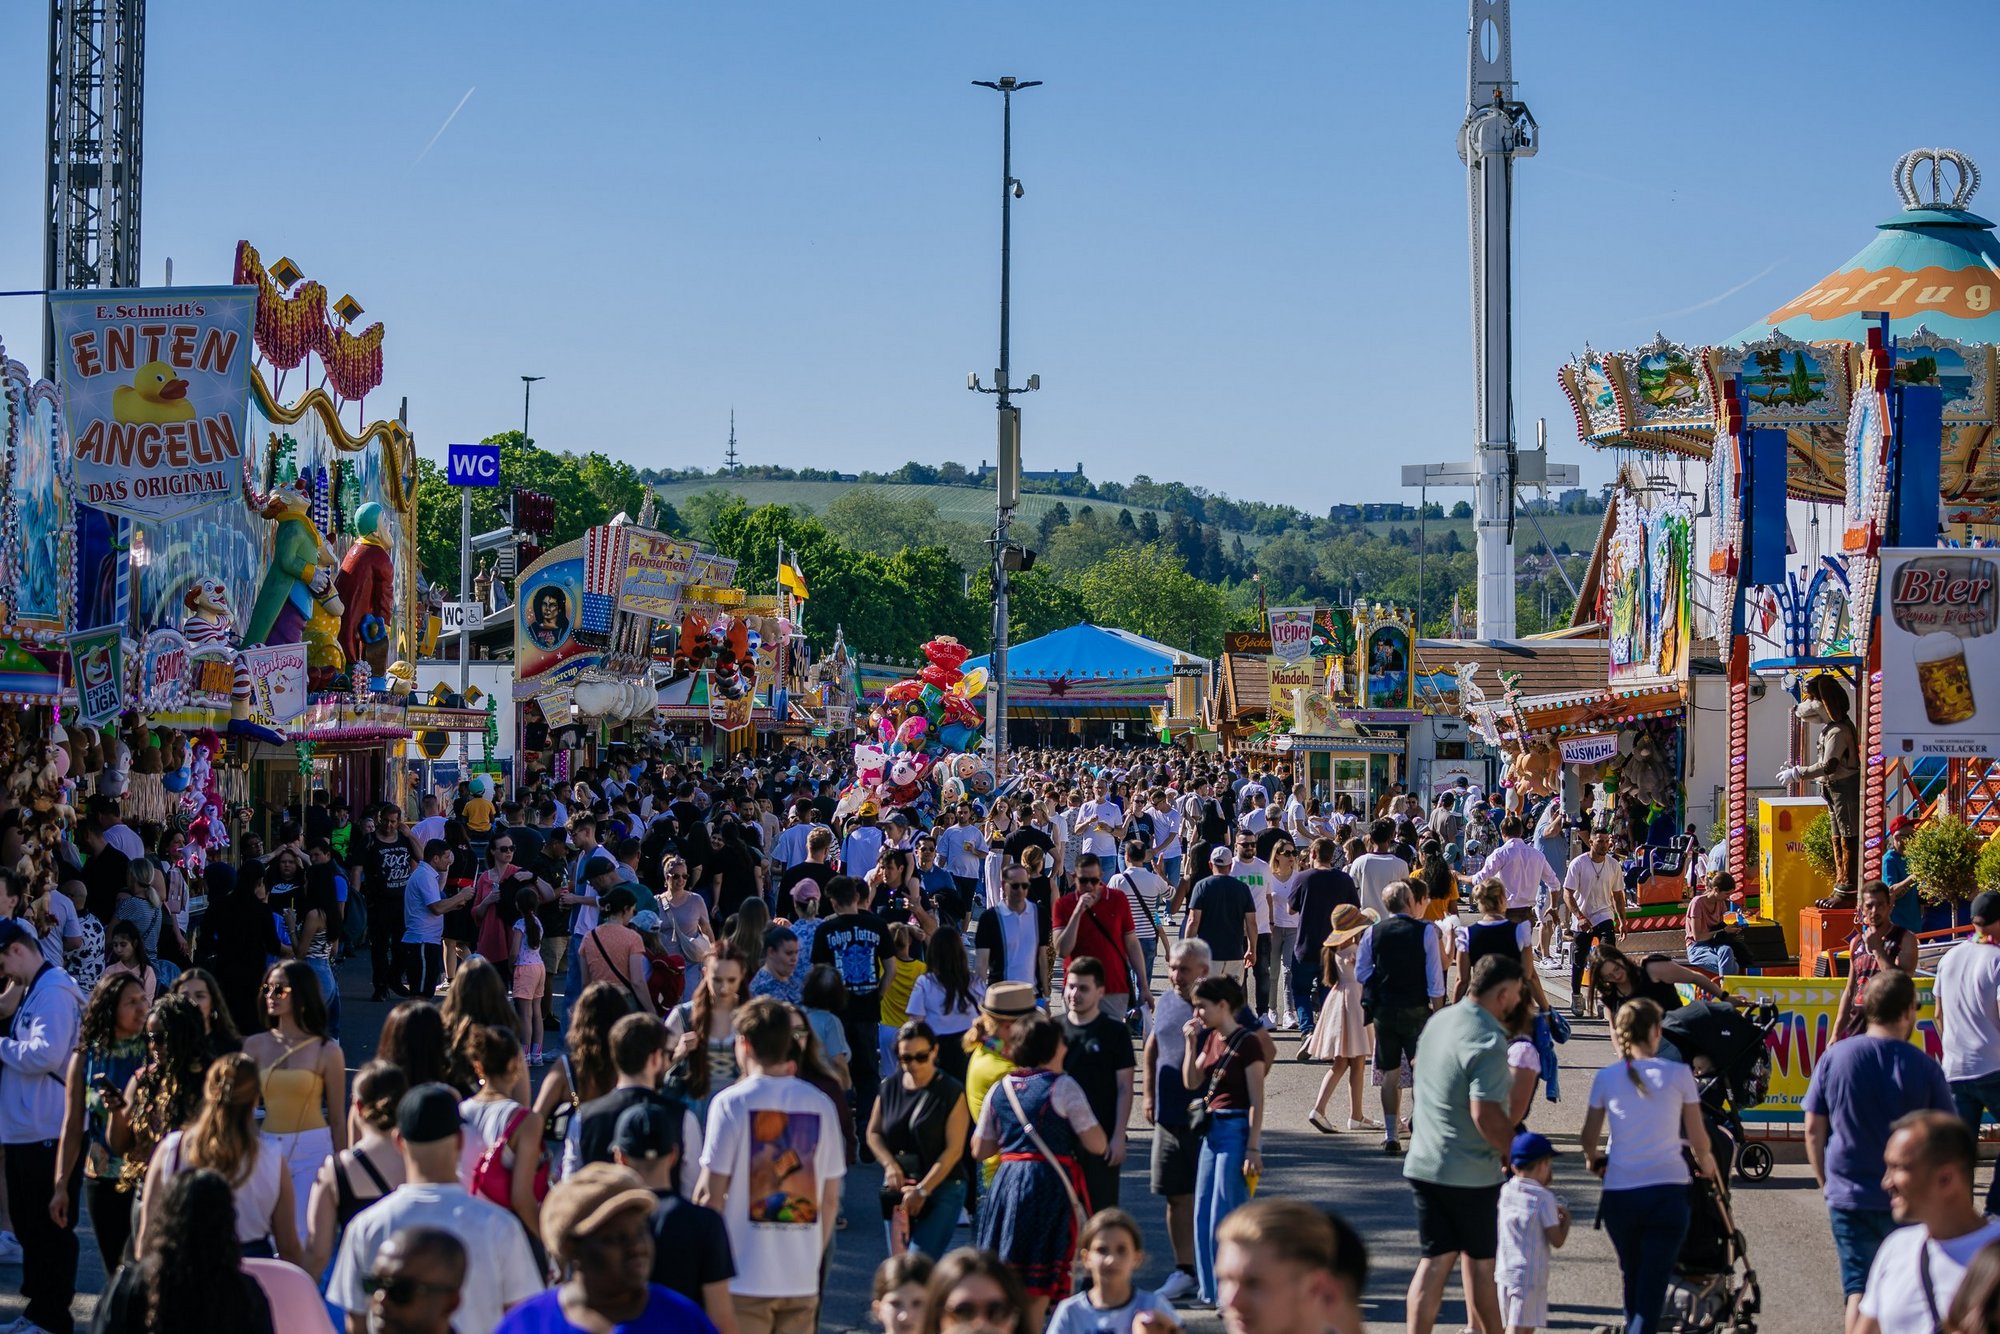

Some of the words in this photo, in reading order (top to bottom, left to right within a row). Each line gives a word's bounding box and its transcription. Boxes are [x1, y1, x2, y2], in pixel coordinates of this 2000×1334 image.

[96, 306, 113, 319] E.
[71, 325, 240, 377] ENTEN
[75, 413, 240, 467] ANGELN
[453, 454, 495, 477] WC
[89, 481, 128, 503] DAS
[133, 471, 229, 498] ORIGINAL
[1894, 568, 1991, 604] Bier
[444, 607, 464, 626] WC
[1272, 623, 1311, 642] Crêpes
[252, 651, 304, 677] Einhorn
[540, 666, 578, 687] Supercup
[1272, 670, 1310, 684] Mandeln
[87, 681, 116, 700] ENTEN
[88, 693, 120, 717] LIGA
[1566, 744, 1614, 760] AUSWAHL
[1922, 745, 1987, 753] DINKELACKER
[383, 852, 410, 867] ROCK
[387, 868, 411, 881] ROLL
